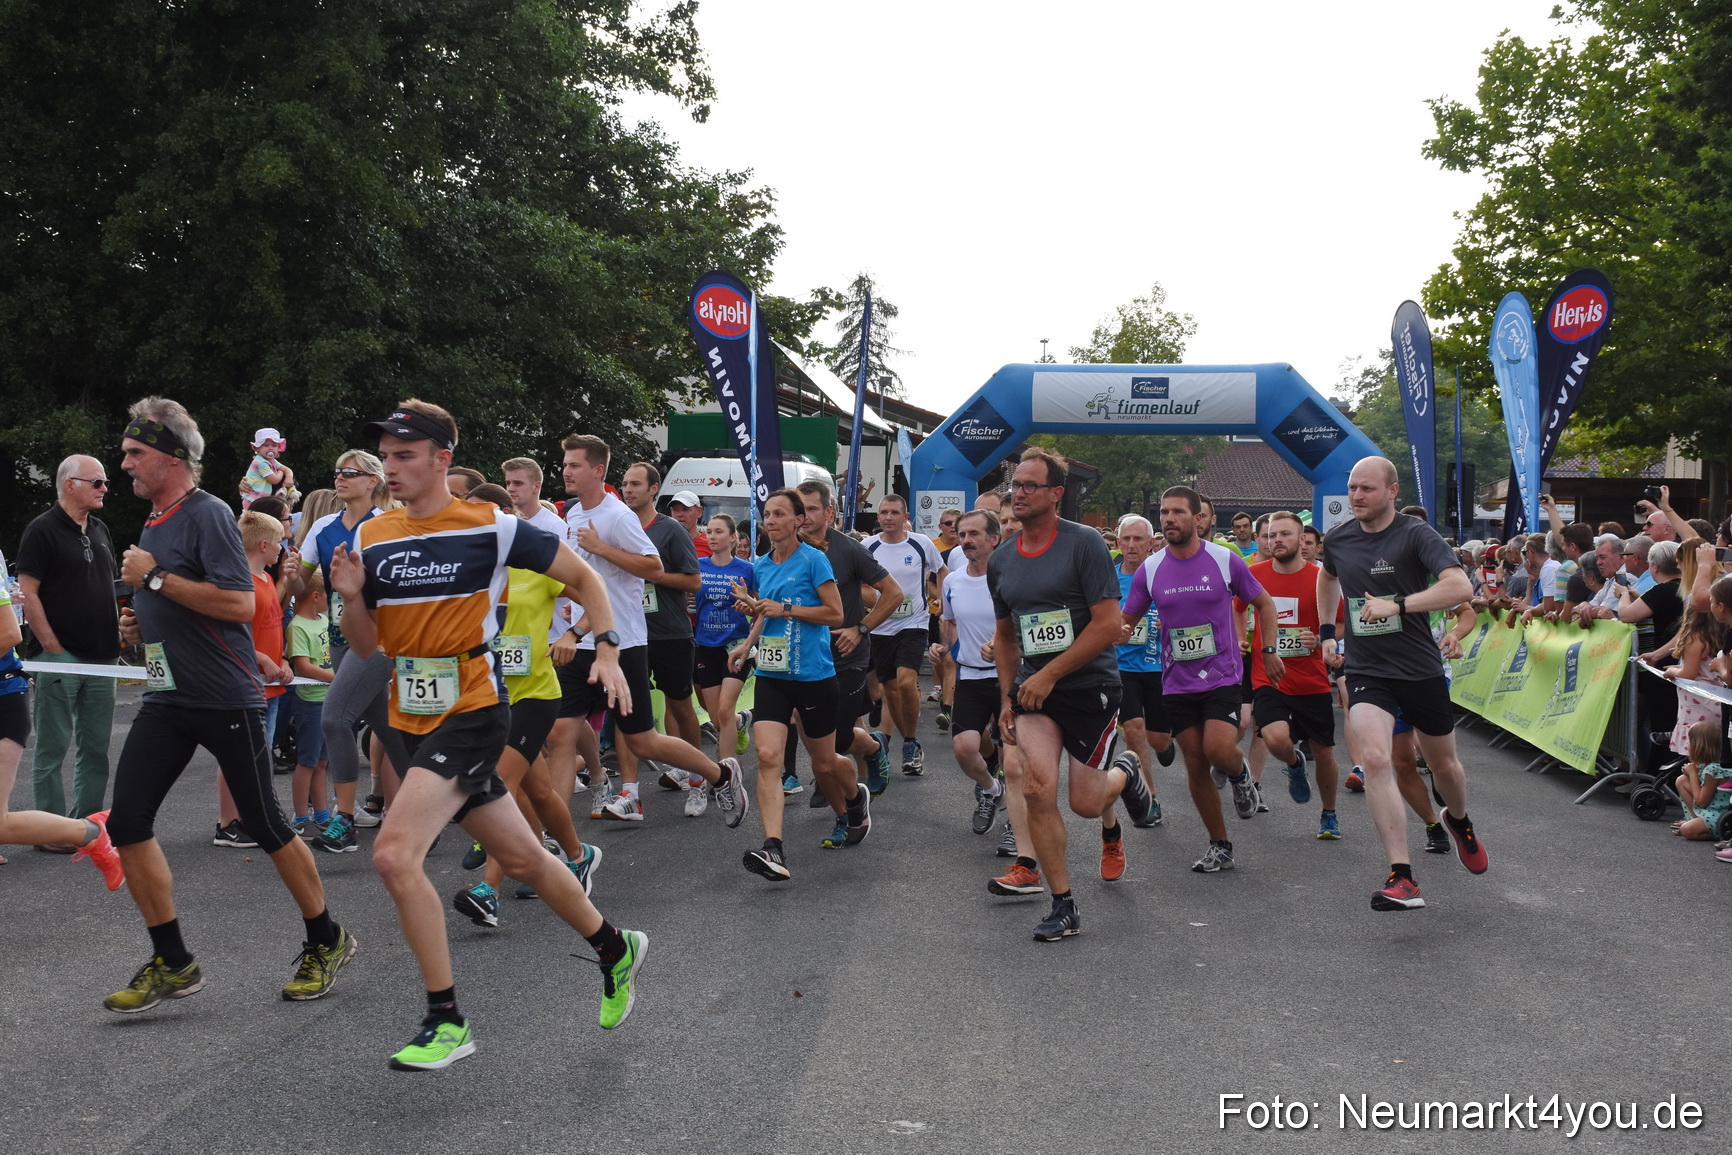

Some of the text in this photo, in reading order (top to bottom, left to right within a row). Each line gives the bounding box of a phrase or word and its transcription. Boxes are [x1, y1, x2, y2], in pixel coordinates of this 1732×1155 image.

[1553, 299, 1603, 329] Hervis
[1139, 384, 1168, 392] Fischer
[1117, 399, 1201, 415] firmenlauf
[960, 426, 1005, 436] Fischer
[670, 477, 706, 485] abavent
[390, 561, 462, 579] Fischer
[397, 575, 456, 587] AUTOMOBILE
[1163, 588, 1177, 596] WIR
[1028, 624, 1067, 644] 1489
[1178, 637, 1204, 652] 907
[1279, 638, 1302, 650] 525
[405, 677, 438, 699] 751
